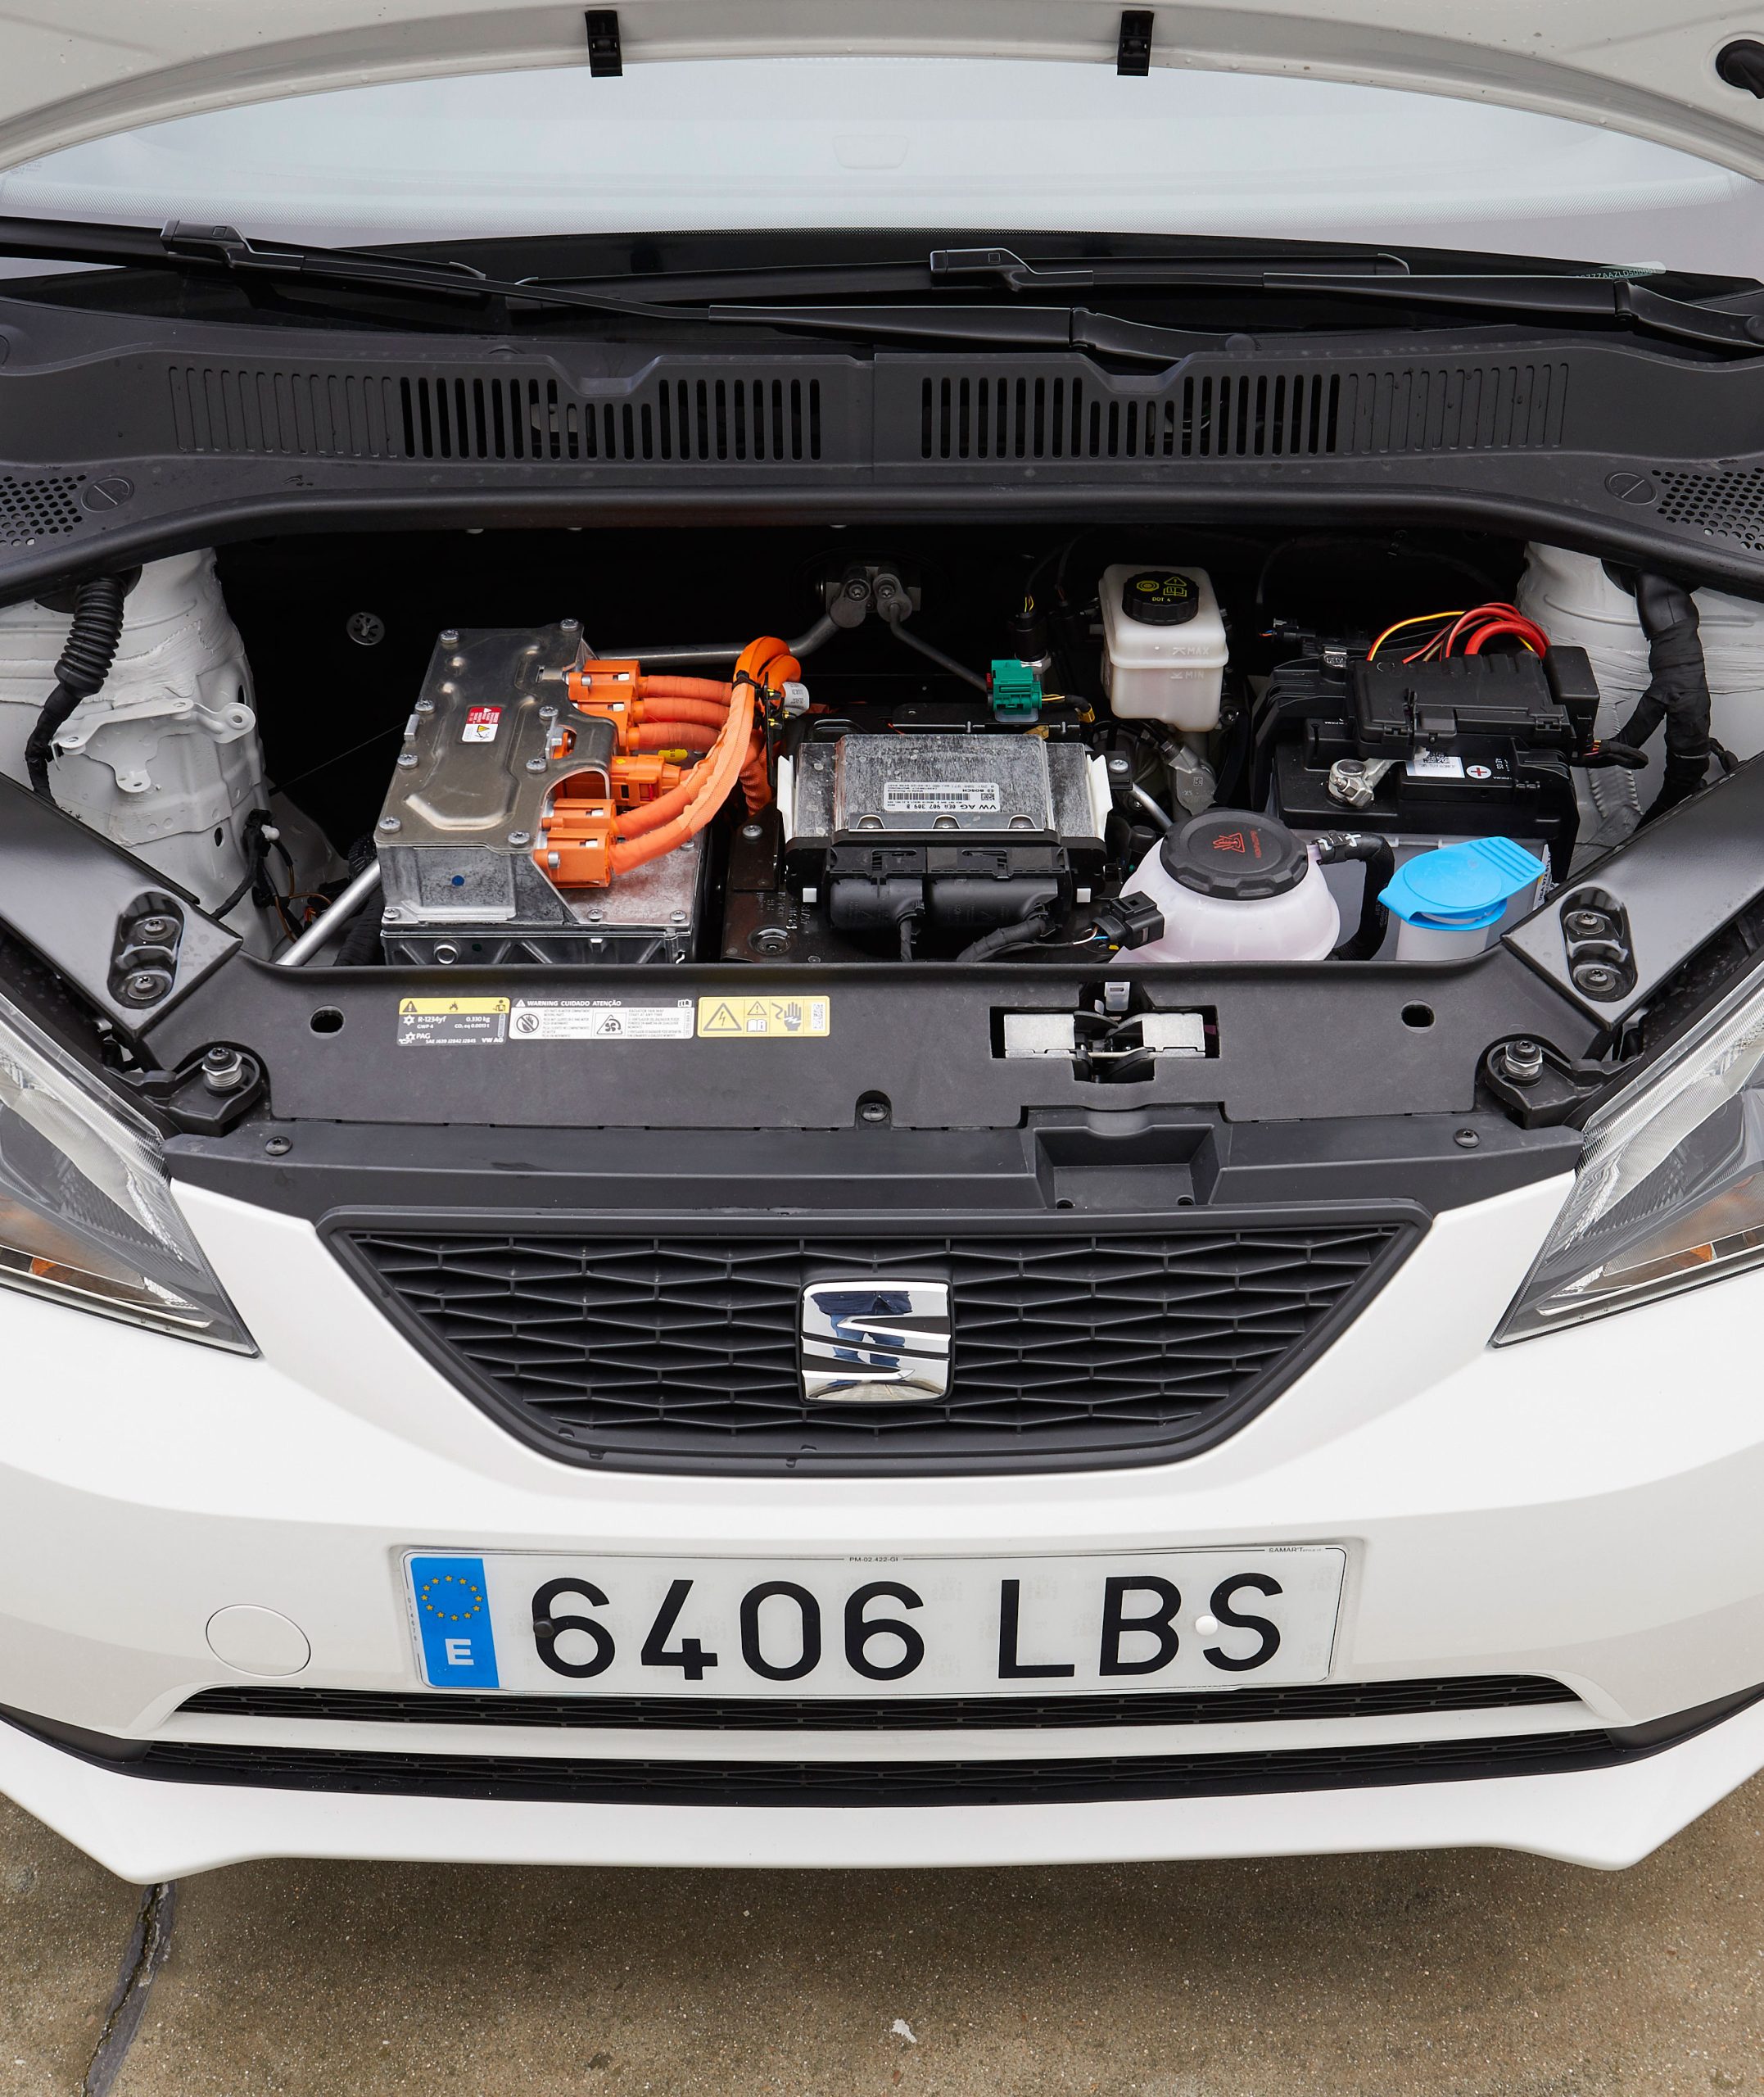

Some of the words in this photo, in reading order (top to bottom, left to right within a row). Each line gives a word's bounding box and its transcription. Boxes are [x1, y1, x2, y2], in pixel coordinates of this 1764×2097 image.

[1187, 647, 1210, 655] MAX
[1185, 671, 1205, 679] MIN
[417, 1016, 446, 1024] R-1234yf
[531, 1577, 925, 1681] 6406
[997, 1572, 1283, 1679] LBS
[445, 1638, 475, 1666] E
